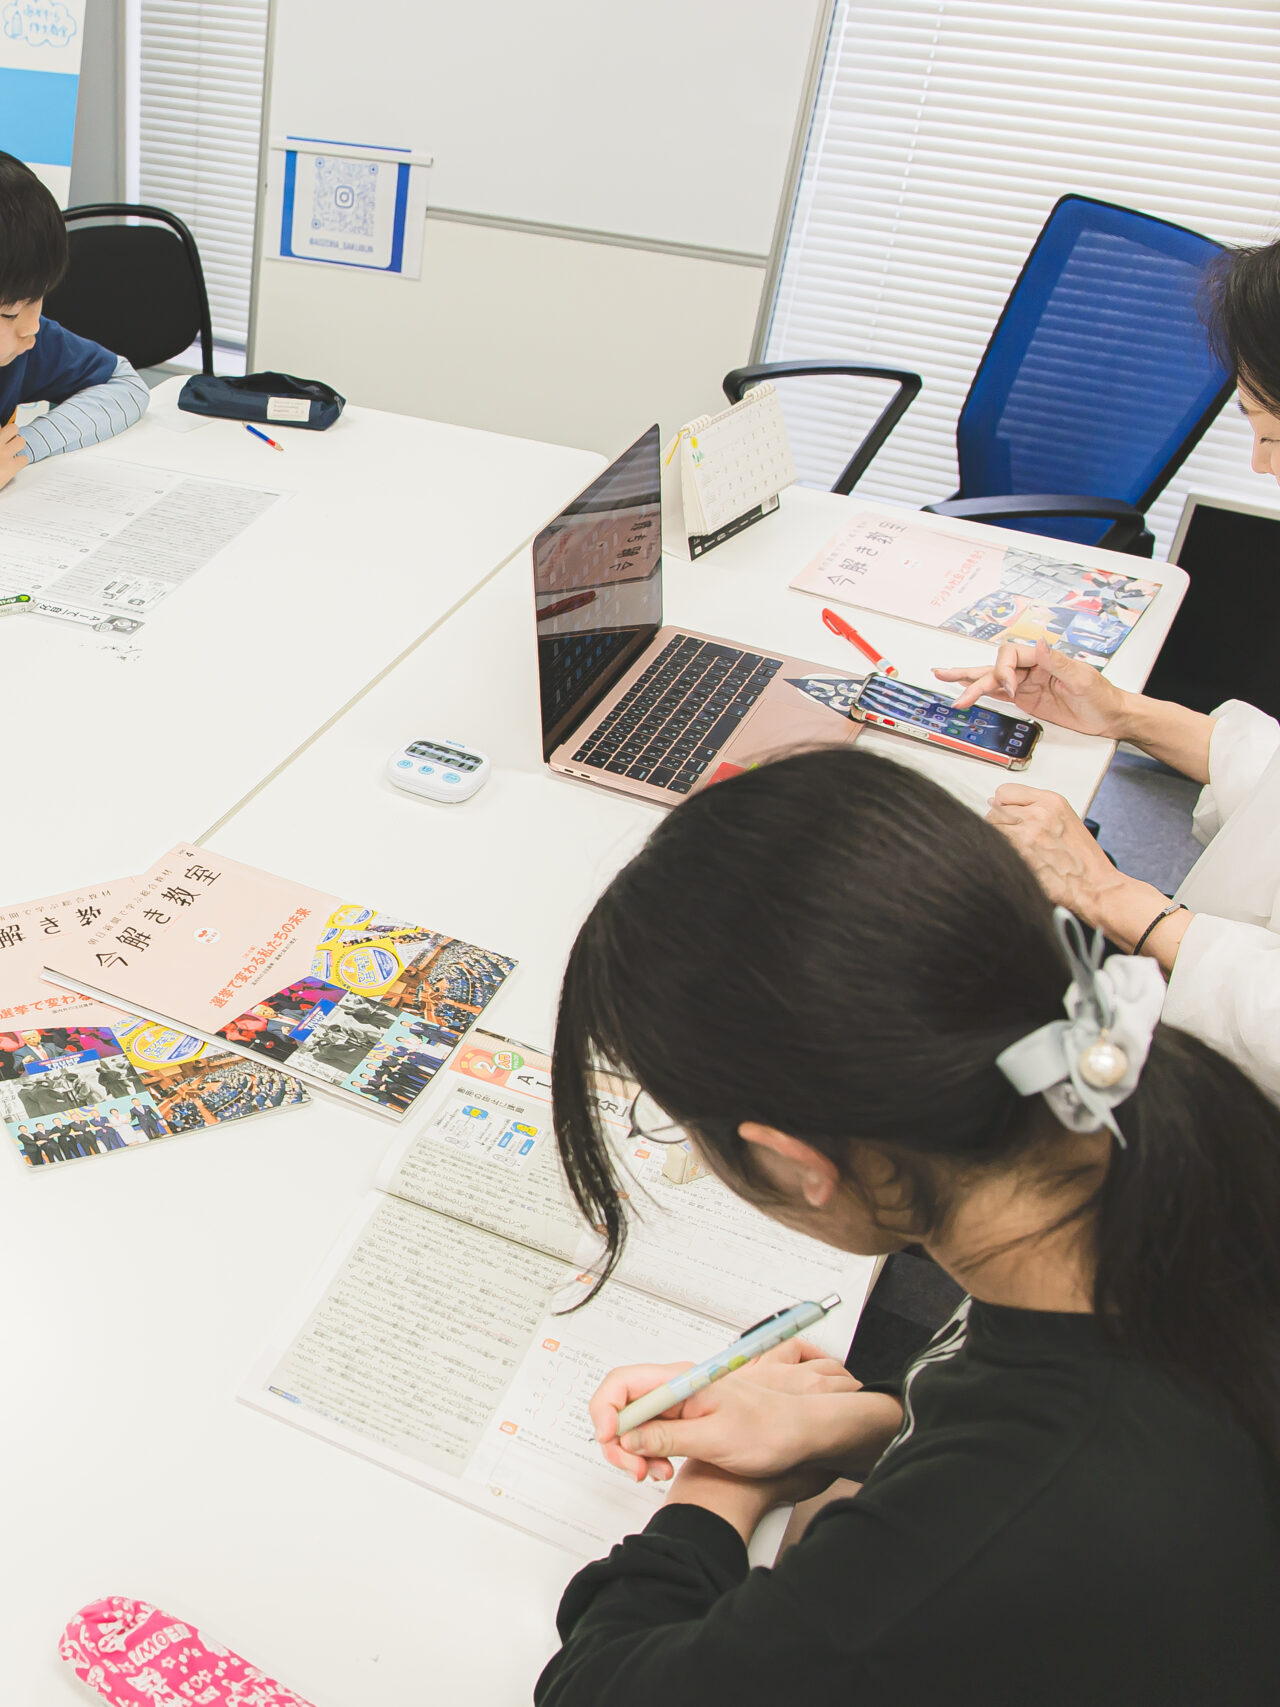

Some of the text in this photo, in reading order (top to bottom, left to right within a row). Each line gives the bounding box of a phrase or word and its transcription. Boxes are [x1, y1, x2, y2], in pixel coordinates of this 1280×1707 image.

[826, 520, 908, 587] 今解き教室
[95, 864, 222, 968] 今解き教室
[209, 906, 312, 1009] 選挙で変わる私たちの未来
[47, 1056, 81, 1071] TRUMP
[480, 1061, 497, 1075] 2
[500, 1052, 514, 1070] 入門
